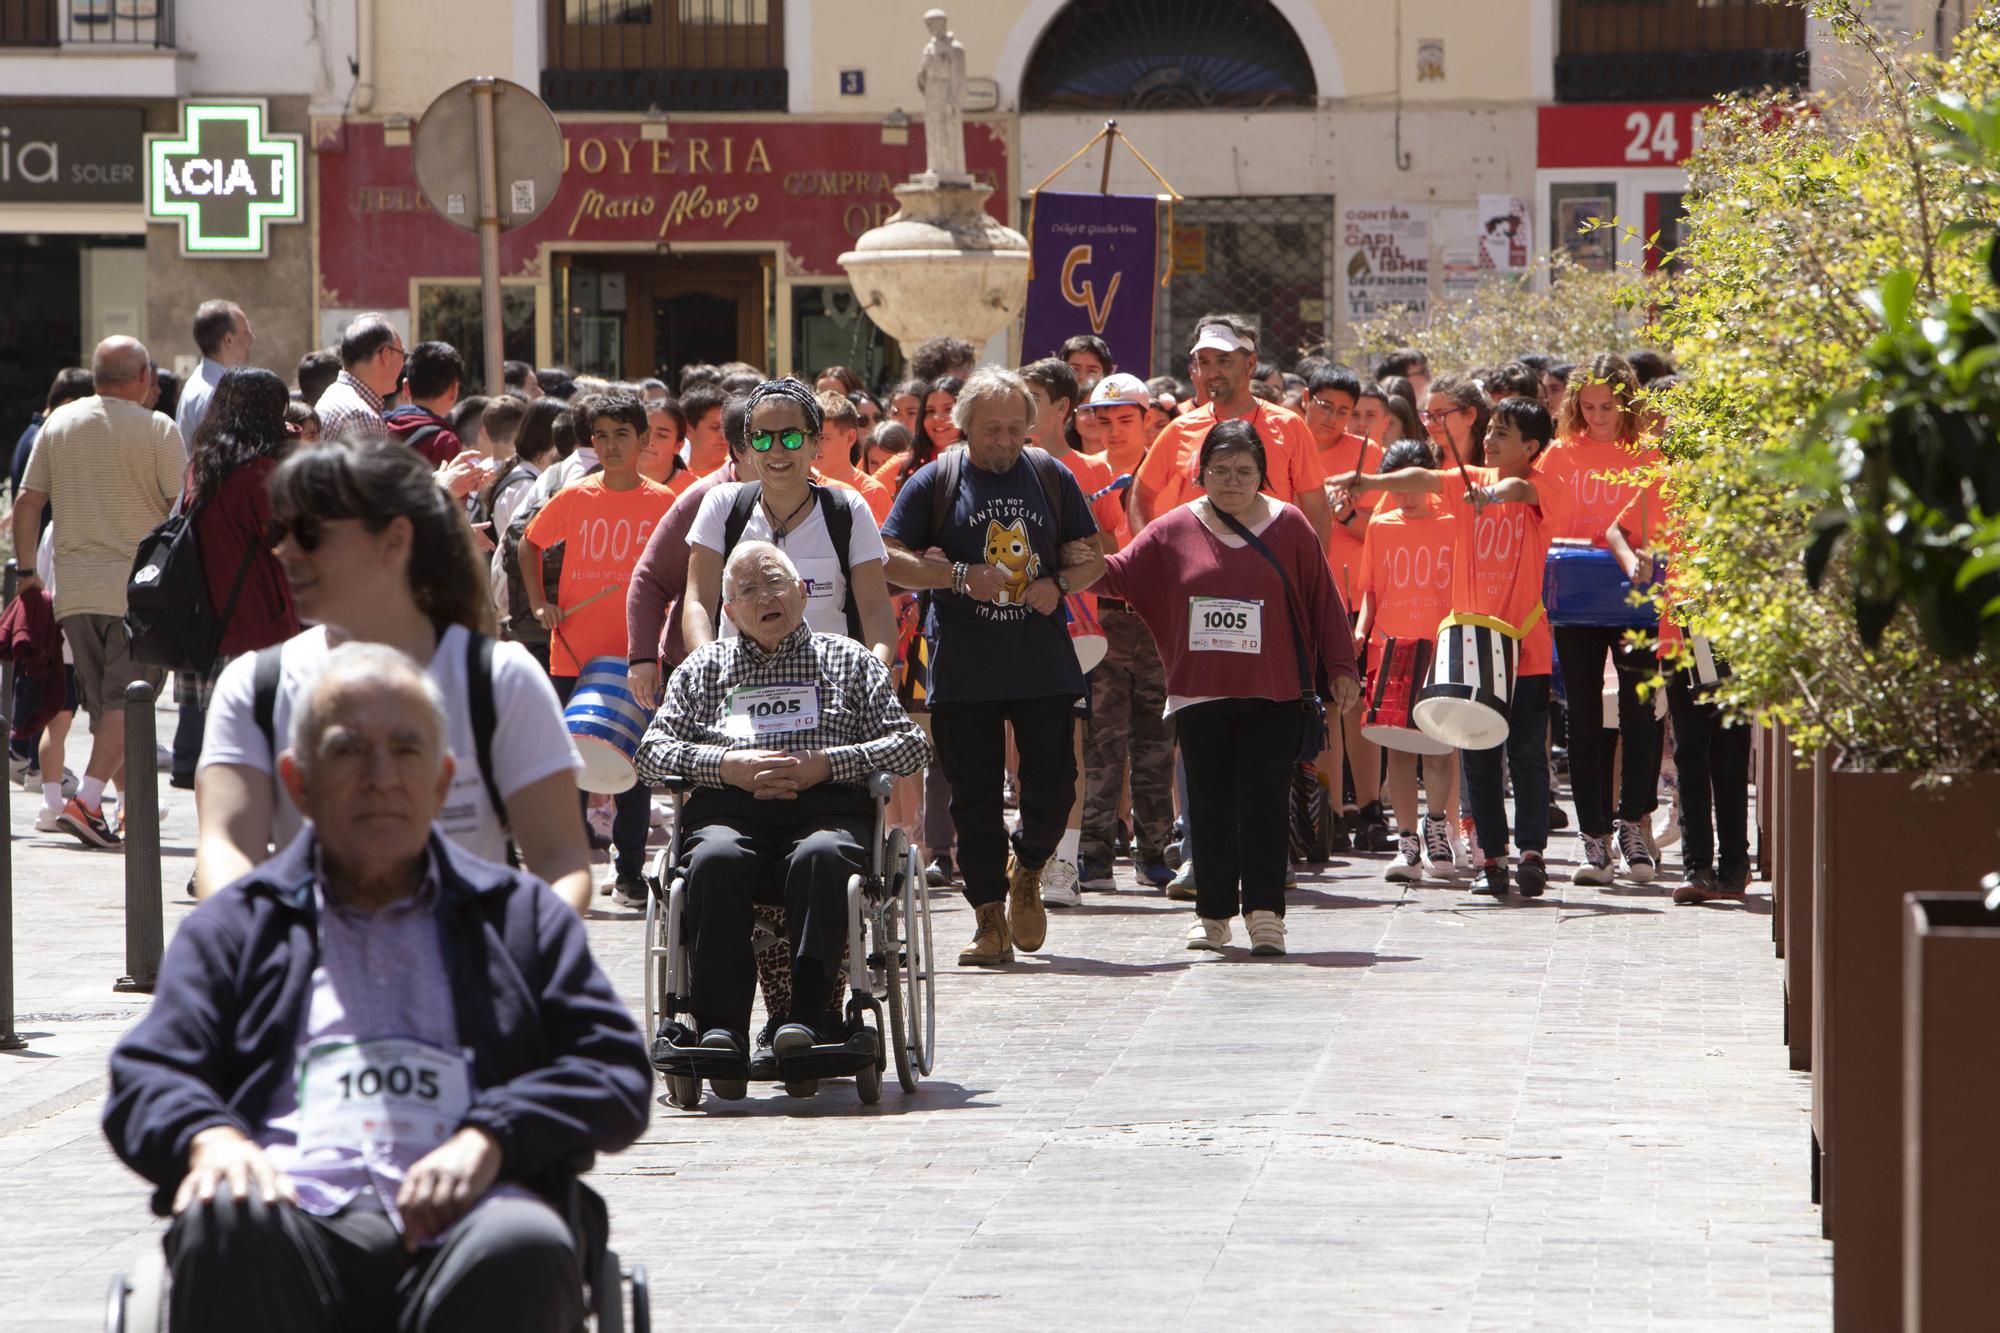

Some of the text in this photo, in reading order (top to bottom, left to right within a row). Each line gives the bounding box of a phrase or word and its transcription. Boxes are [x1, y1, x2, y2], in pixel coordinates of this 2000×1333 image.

[846, 73, 858, 93] 3
[1625, 111, 1679, 161] 24
[71, 163, 135, 184] SOLER
[784, 170, 893, 195] COMPRA
[568, 188, 655, 236] Mario
[659, 185, 760, 236] Alonso
[1345, 208, 1410, 220] CONTRA
[1345, 233, 1394, 246] CAPI
[987, 498, 1003, 507] I'M
[969, 506, 1045, 527] ANTISOCIAL
[1383, 546, 1450, 588] 1005
[1203, 611, 1247, 629] 1005
[747, 699, 801, 718] 1005
[338, 1065, 439, 1099] 1005
